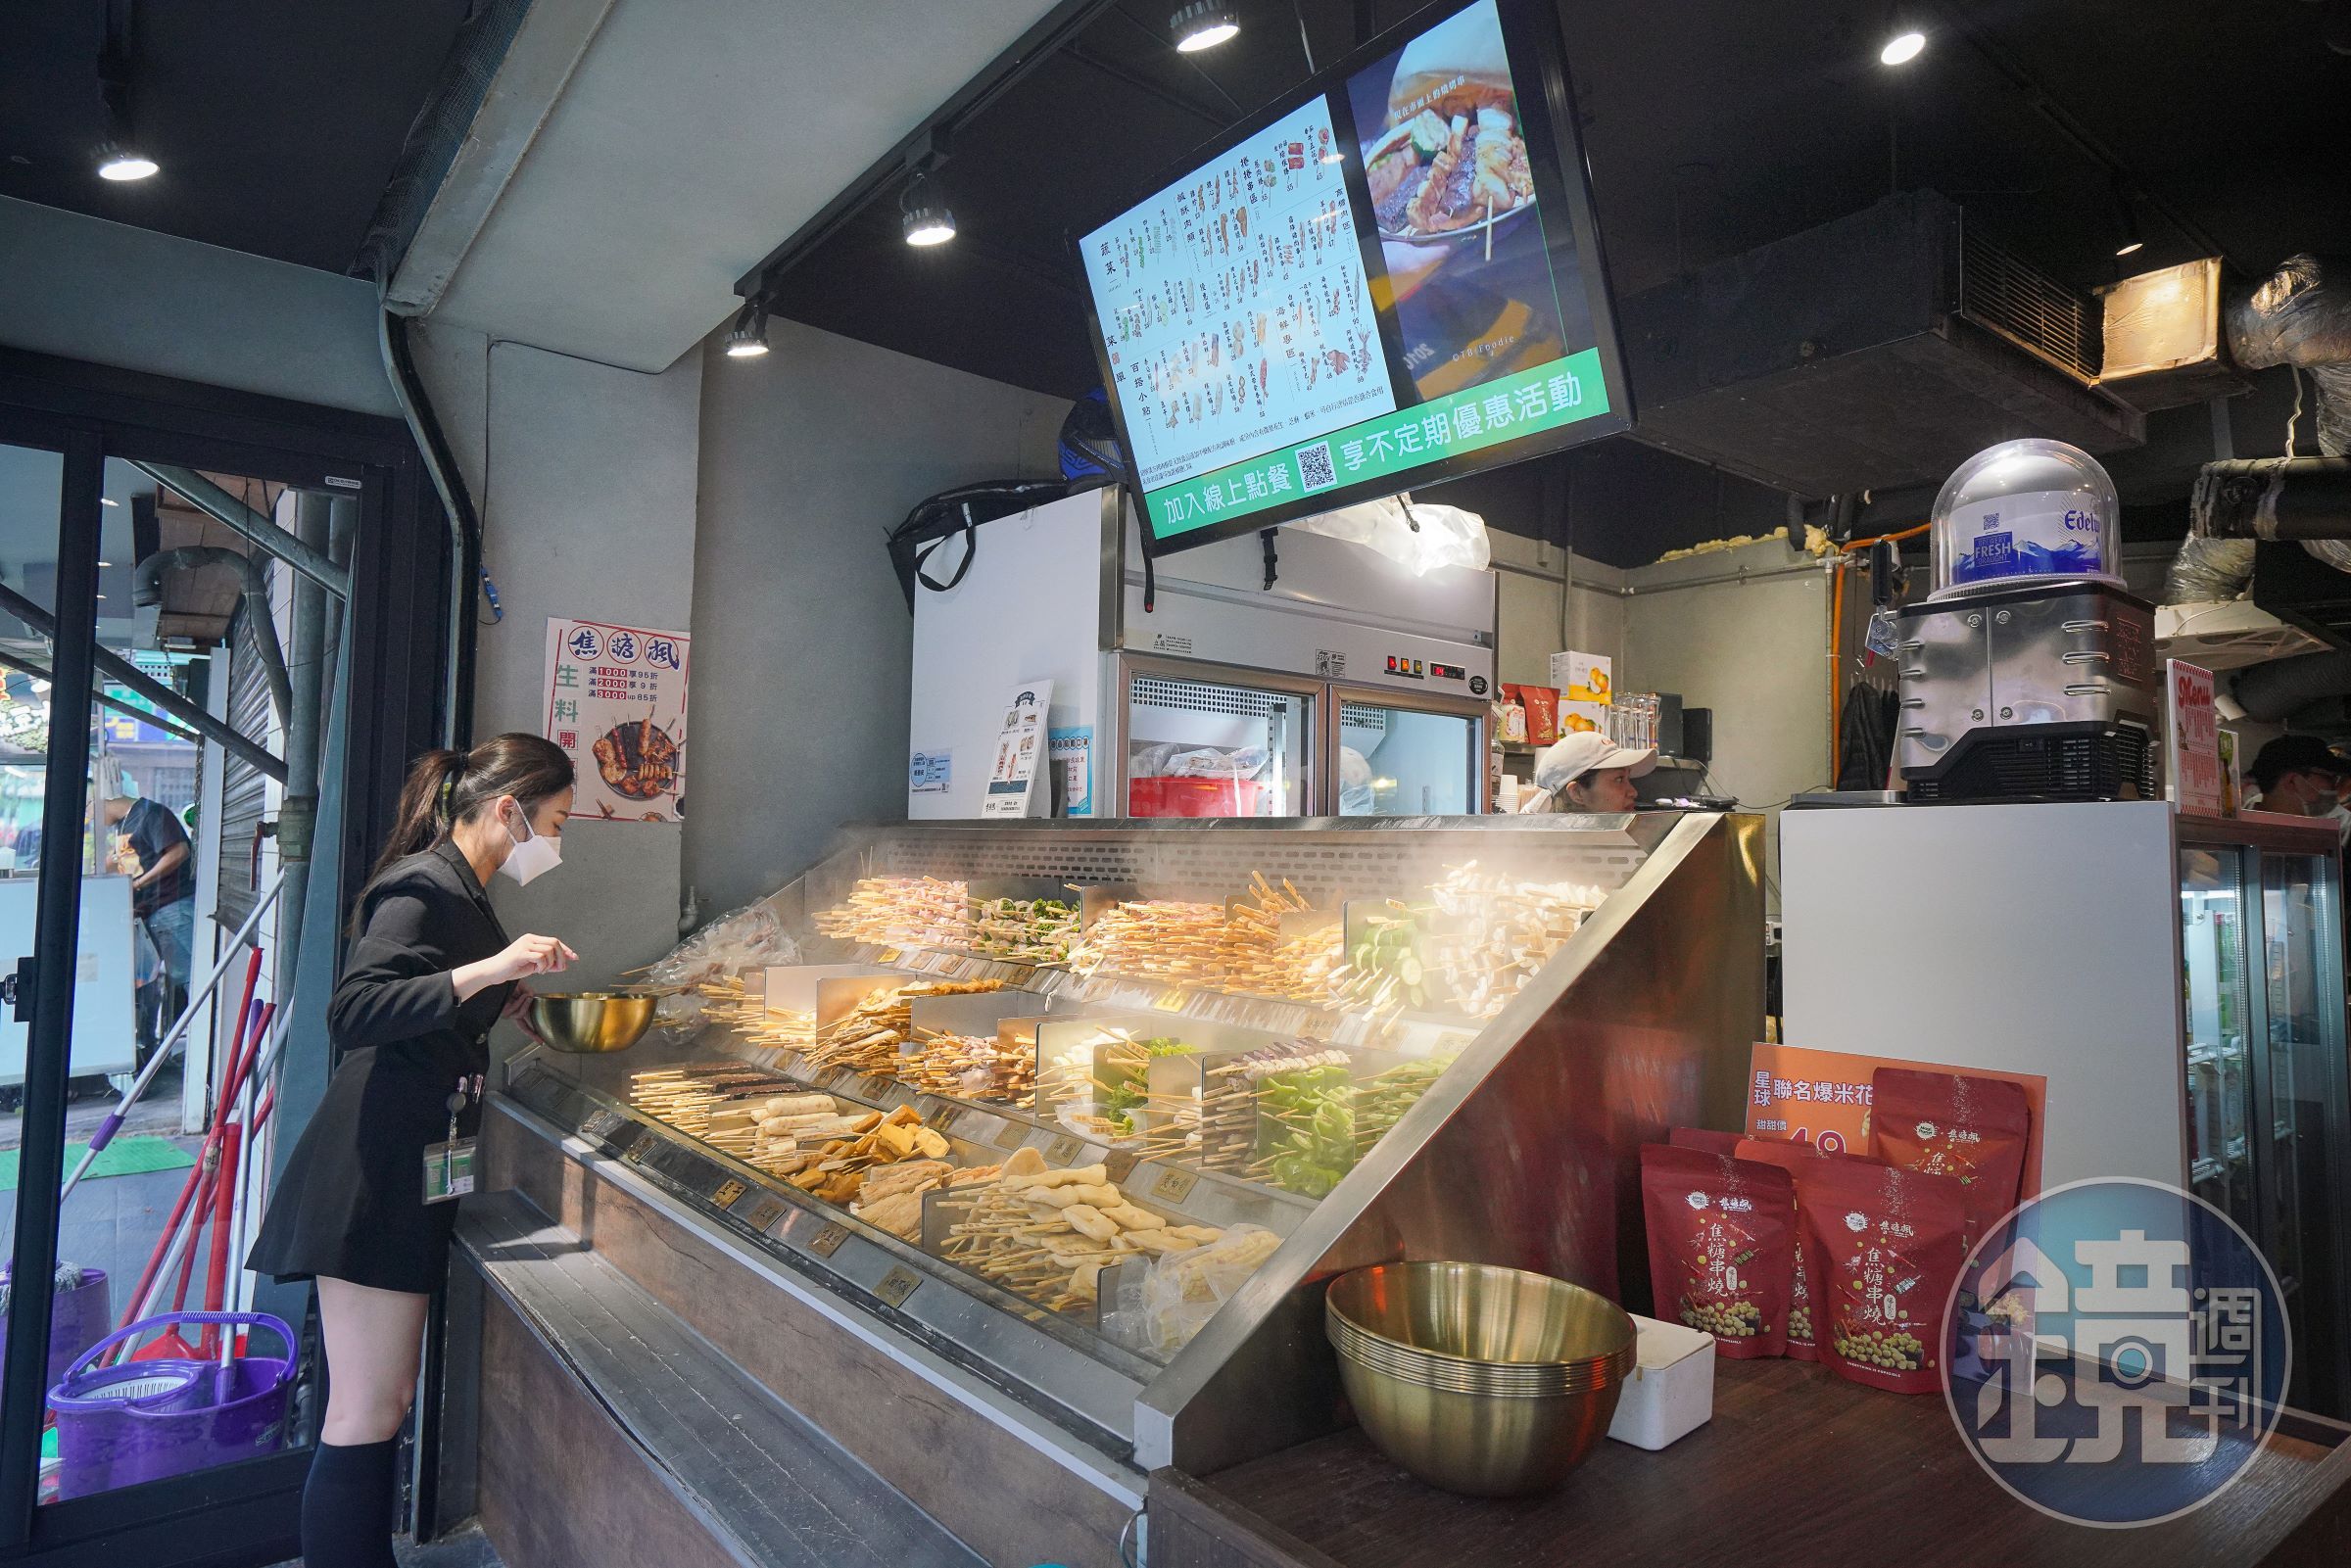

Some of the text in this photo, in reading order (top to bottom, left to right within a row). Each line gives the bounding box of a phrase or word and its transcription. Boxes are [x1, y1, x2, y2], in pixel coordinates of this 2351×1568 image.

[1130, 361, 1151, 415] 百搭小點
[1164, 371, 1584, 525] 加入線上點餐 享不定期優惠活動
[1975, 543, 2011, 558] FRESH
[1978, 554, 2007, 565] DRAUGHT
[569, 630, 680, 670] 焦糖楓
[2179, 677, 2211, 707] Menu
[1754, 1071, 1771, 1107] 星球
[1774, 1079, 1873, 1106] 聯名爆米花
[1756, 1119, 1787, 1131] 甜甜價
[1707, 1223, 1728, 1296] 焦糖串燒
[1863, 1247, 1886, 1326] 焦糖串燒
